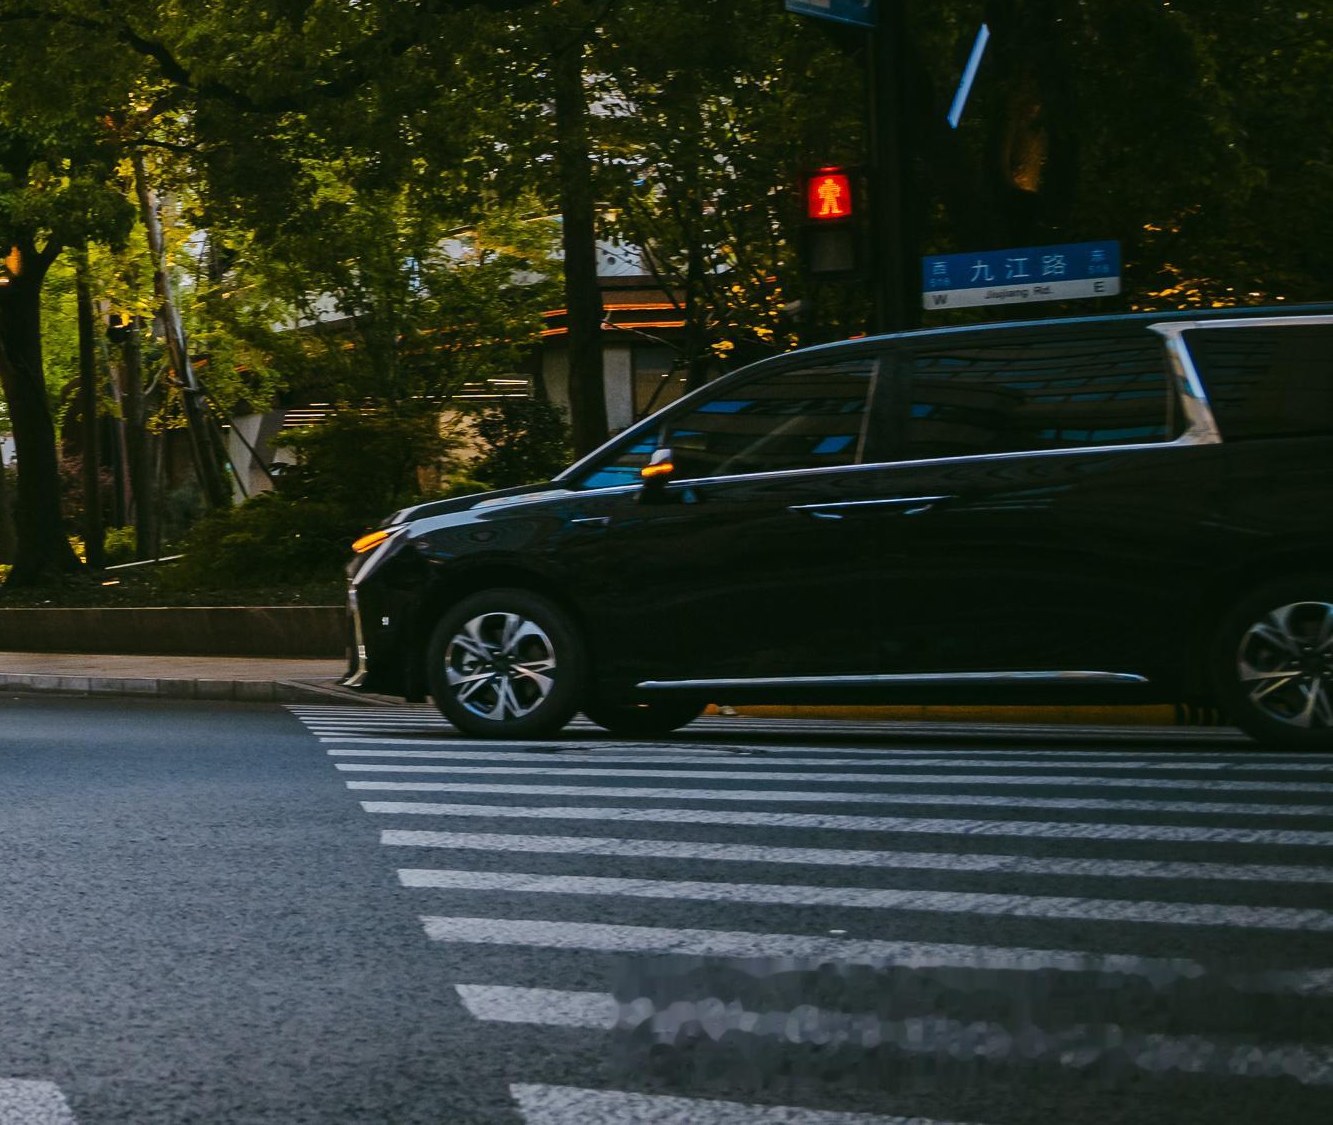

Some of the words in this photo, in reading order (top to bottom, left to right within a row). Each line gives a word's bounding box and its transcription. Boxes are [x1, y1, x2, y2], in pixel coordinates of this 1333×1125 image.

[971, 254, 1067, 282] 九江路
[933, 294, 948, 305] W
[984, 288, 1029, 299] Jiujiang
[1094, 281, 1104, 293] E
